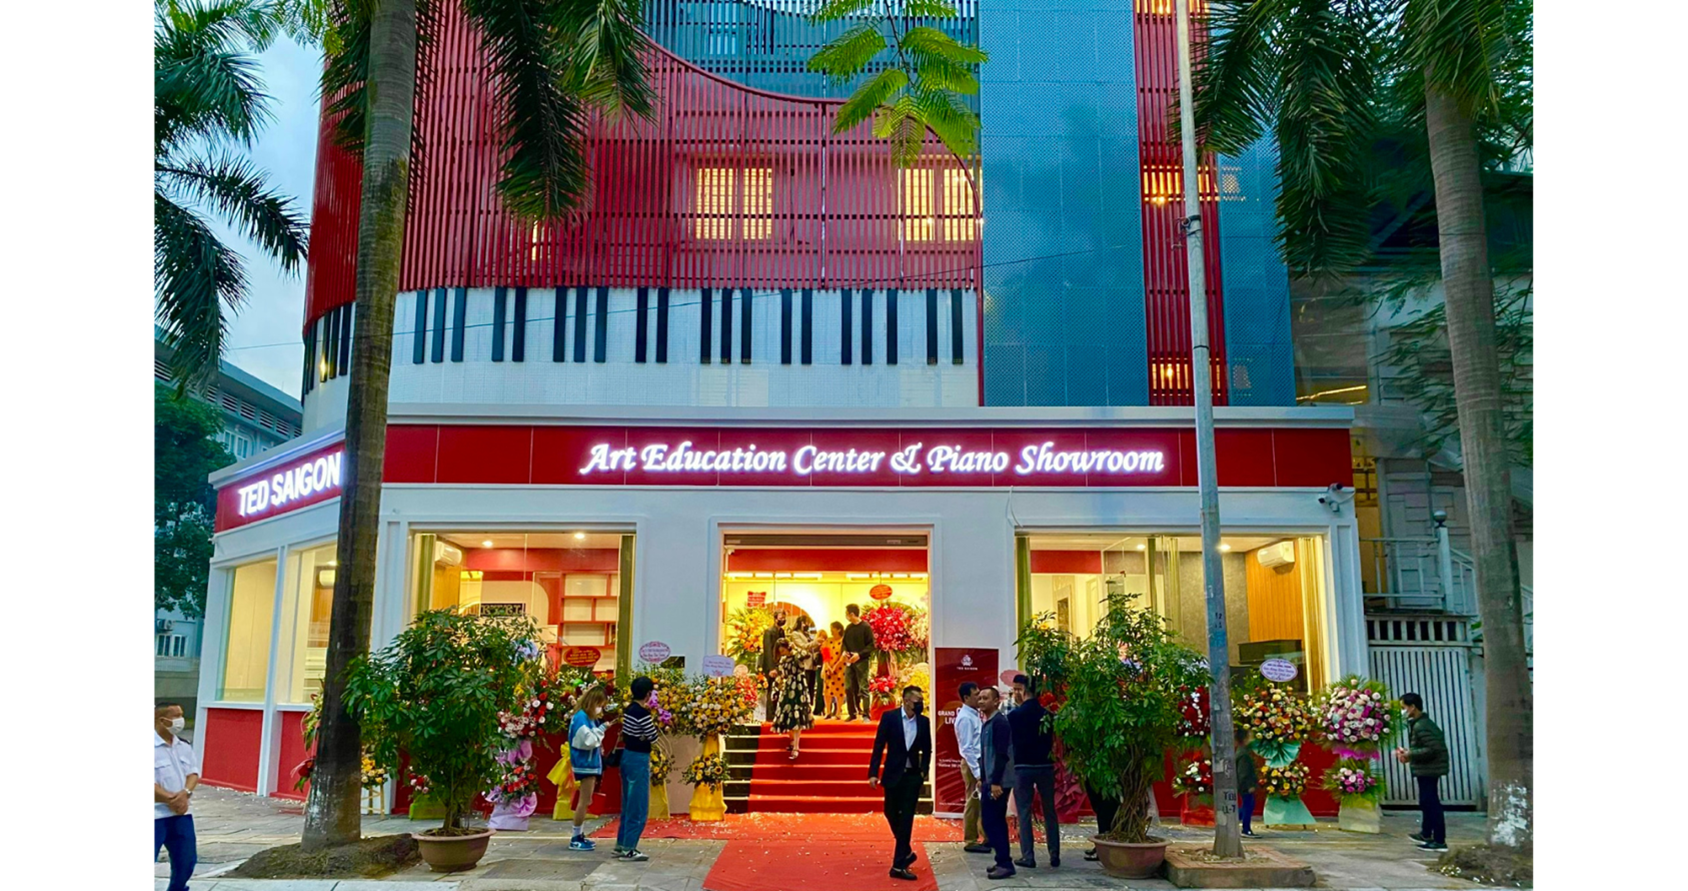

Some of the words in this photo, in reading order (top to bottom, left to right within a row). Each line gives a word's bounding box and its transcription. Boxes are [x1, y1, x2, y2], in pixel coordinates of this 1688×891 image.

[579, 444, 636, 474] Art
[641, 441, 787, 471] Education
[793, 445, 886, 475] Center
[890, 442, 922, 474] &
[927, 445, 1009, 472] Piano
[1015, 442, 1165, 474] Showroom
[237, 479, 270, 517] TED
[270, 451, 342, 507] SAIGON
